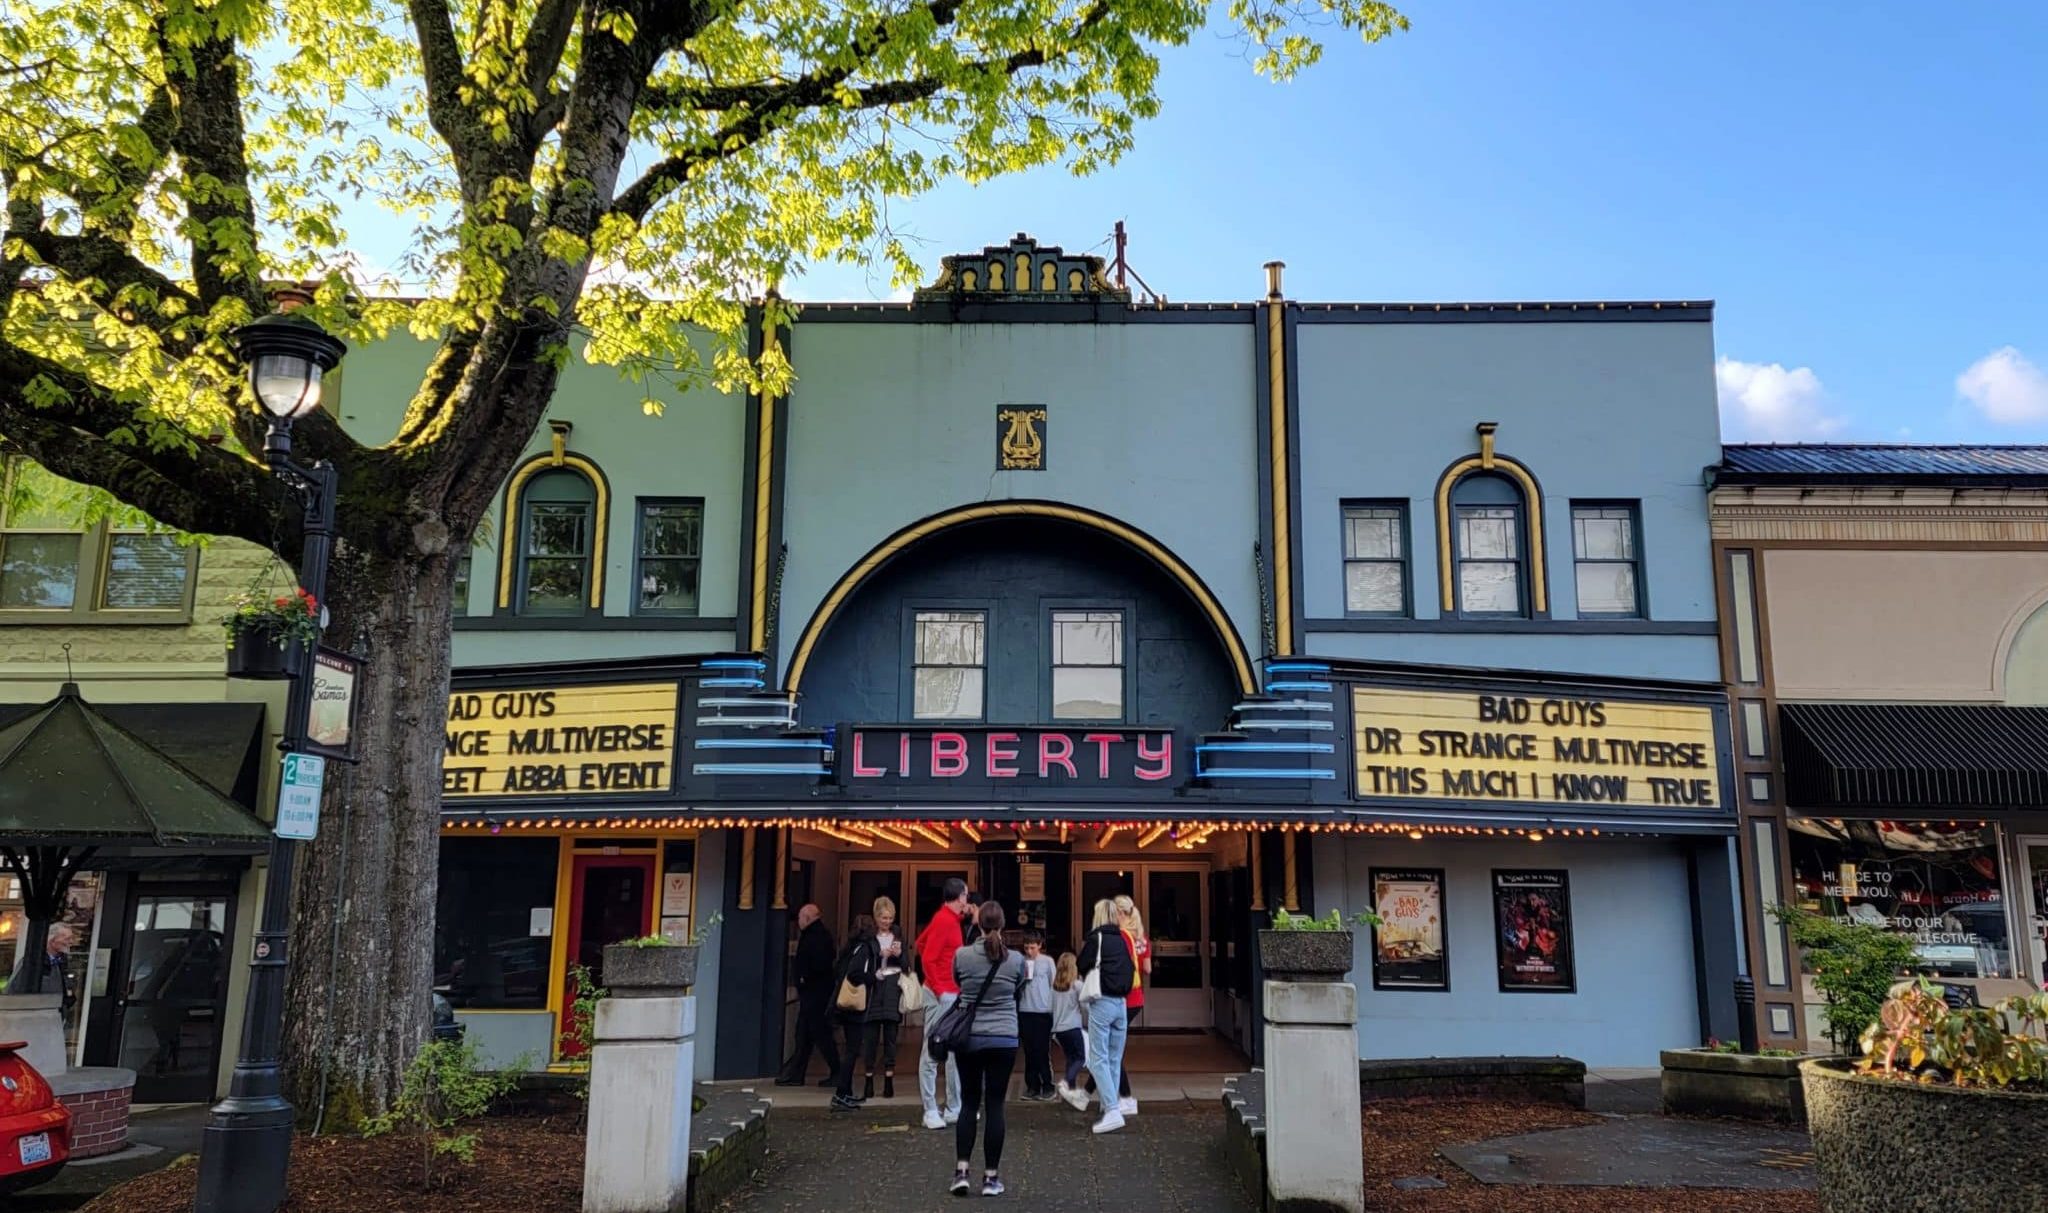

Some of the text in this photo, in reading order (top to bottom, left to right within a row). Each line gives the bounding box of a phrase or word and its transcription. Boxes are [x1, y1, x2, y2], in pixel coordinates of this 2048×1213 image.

[312, 677, 349, 701] Camas
[492, 691, 557, 720] GUYS
[1479, 695, 1607, 728] BAD GUYS
[506, 723, 666, 756] MULTIVERSE
[1365, 727, 1708, 769] DR STRANGE MULTIVERSE
[853, 732, 1172, 781] LIBERTY
[286, 760, 297, 781] 2
[502, 765, 568, 793] ABBA
[578, 761, 665, 791] EVENT
[1367, 766, 1715, 806] THIS MUCH I KNOW TRUE
[1873, 871, 1892, 883] TO
[1398, 896, 1420, 909] BAD
[1860, 886, 1892, 898] YOU.
[1394, 906, 1421, 919] GUYS
[1894, 917, 1912, 928] TO
[1914, 917, 1944, 928] OUR
